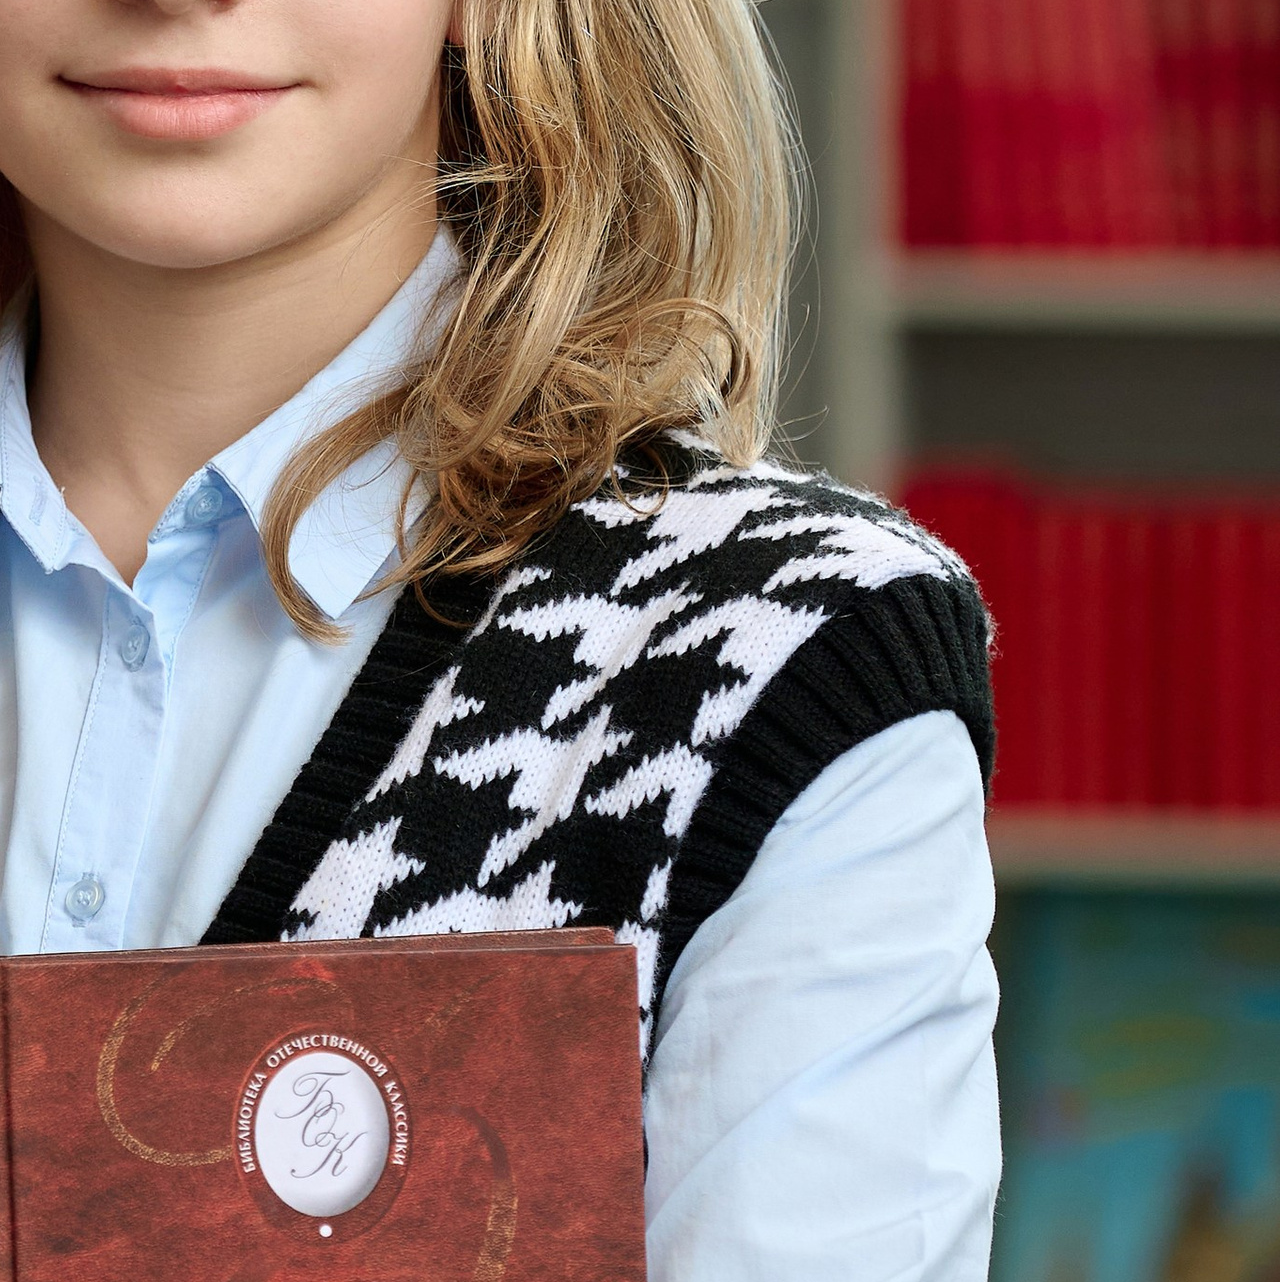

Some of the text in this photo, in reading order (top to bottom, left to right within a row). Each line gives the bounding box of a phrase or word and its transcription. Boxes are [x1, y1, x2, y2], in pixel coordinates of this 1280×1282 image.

[238, 1034, 408, 1173] БИБЛИОТЕКА ОТЕЧЕСТВЕННОЙ КЛАССИКИ
